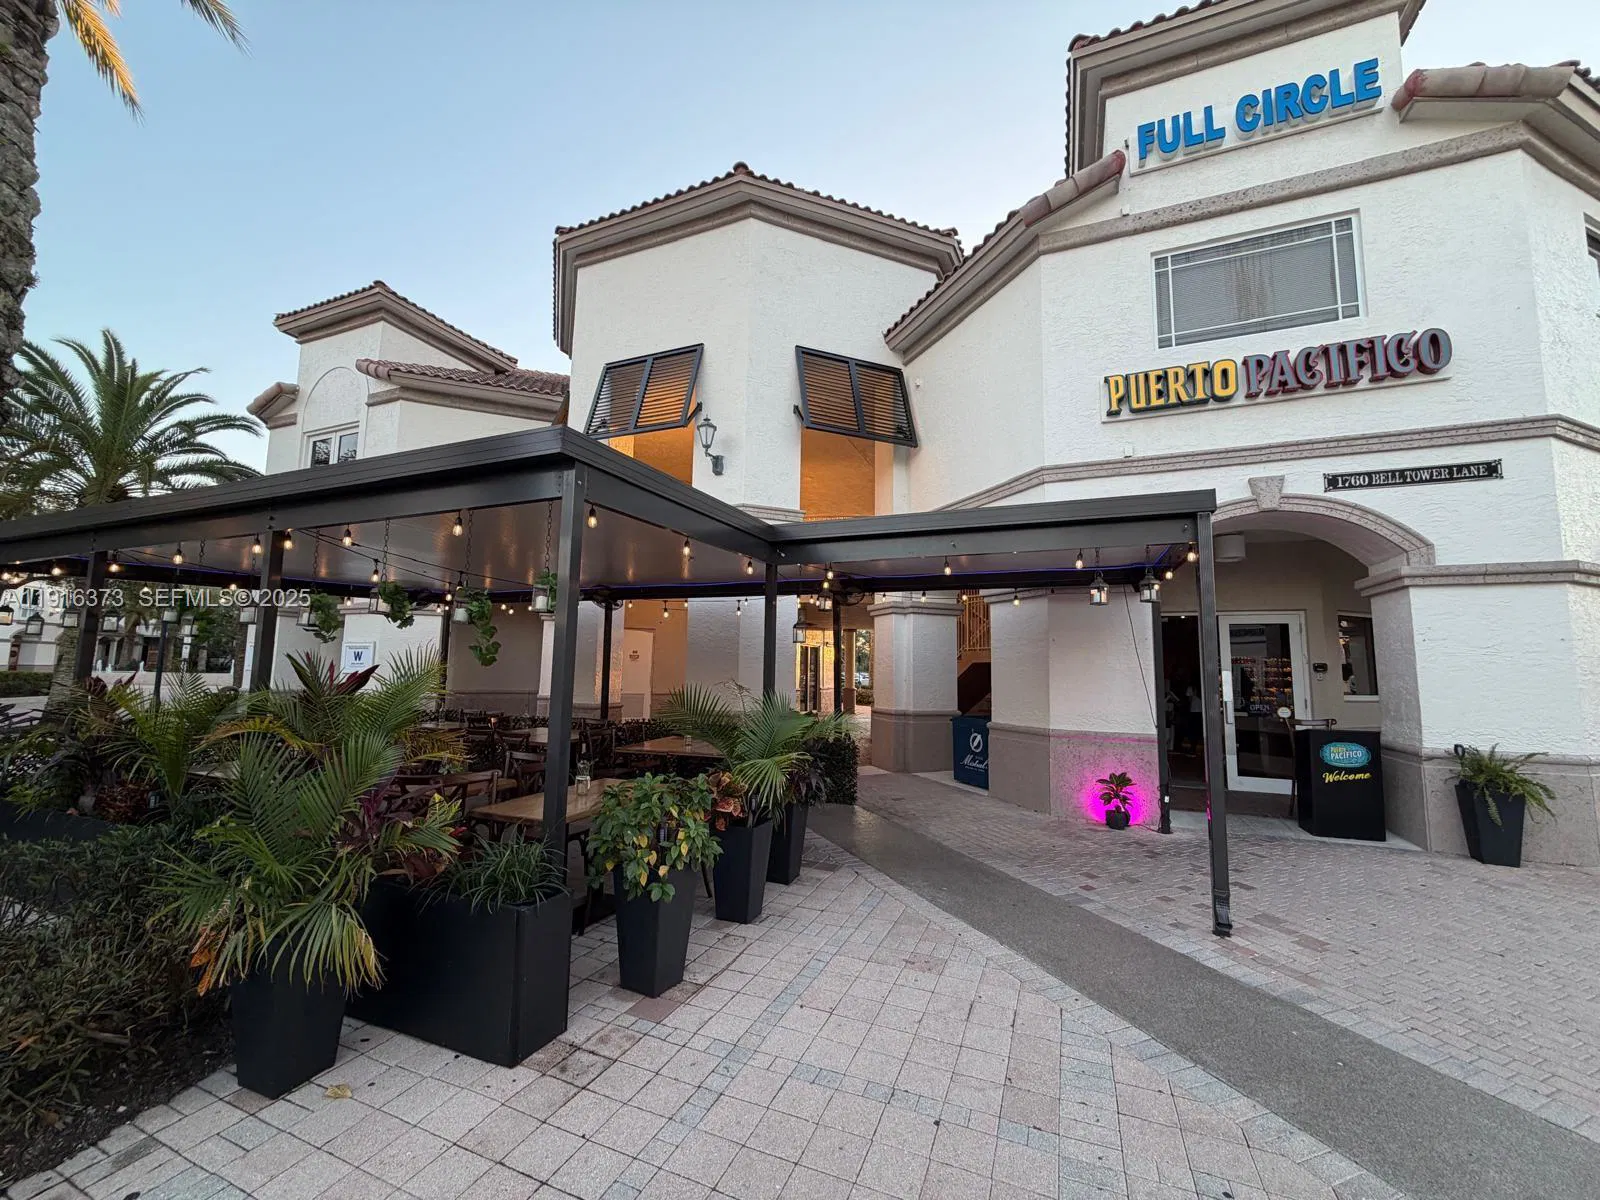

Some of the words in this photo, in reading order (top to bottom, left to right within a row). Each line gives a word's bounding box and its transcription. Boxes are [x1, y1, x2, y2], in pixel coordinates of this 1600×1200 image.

[1137, 105, 1226, 161] FULL
[1235, 57, 1382, 133] CIRCLE
[1104, 358, 1239, 416] PUERTO
[1242, 327, 1453, 398] PACIFICO
[1336, 475, 1369, 488] 1760
[1371, 471, 1402, 486] BELL
[1404, 466, 1450, 482] TOWER
[1452, 464, 1488, 478] LANE
[353, 650, 363, 662] W
[1330, 750, 1362, 760] PACIFICO
[1322, 770, 1371, 783] Welcome
